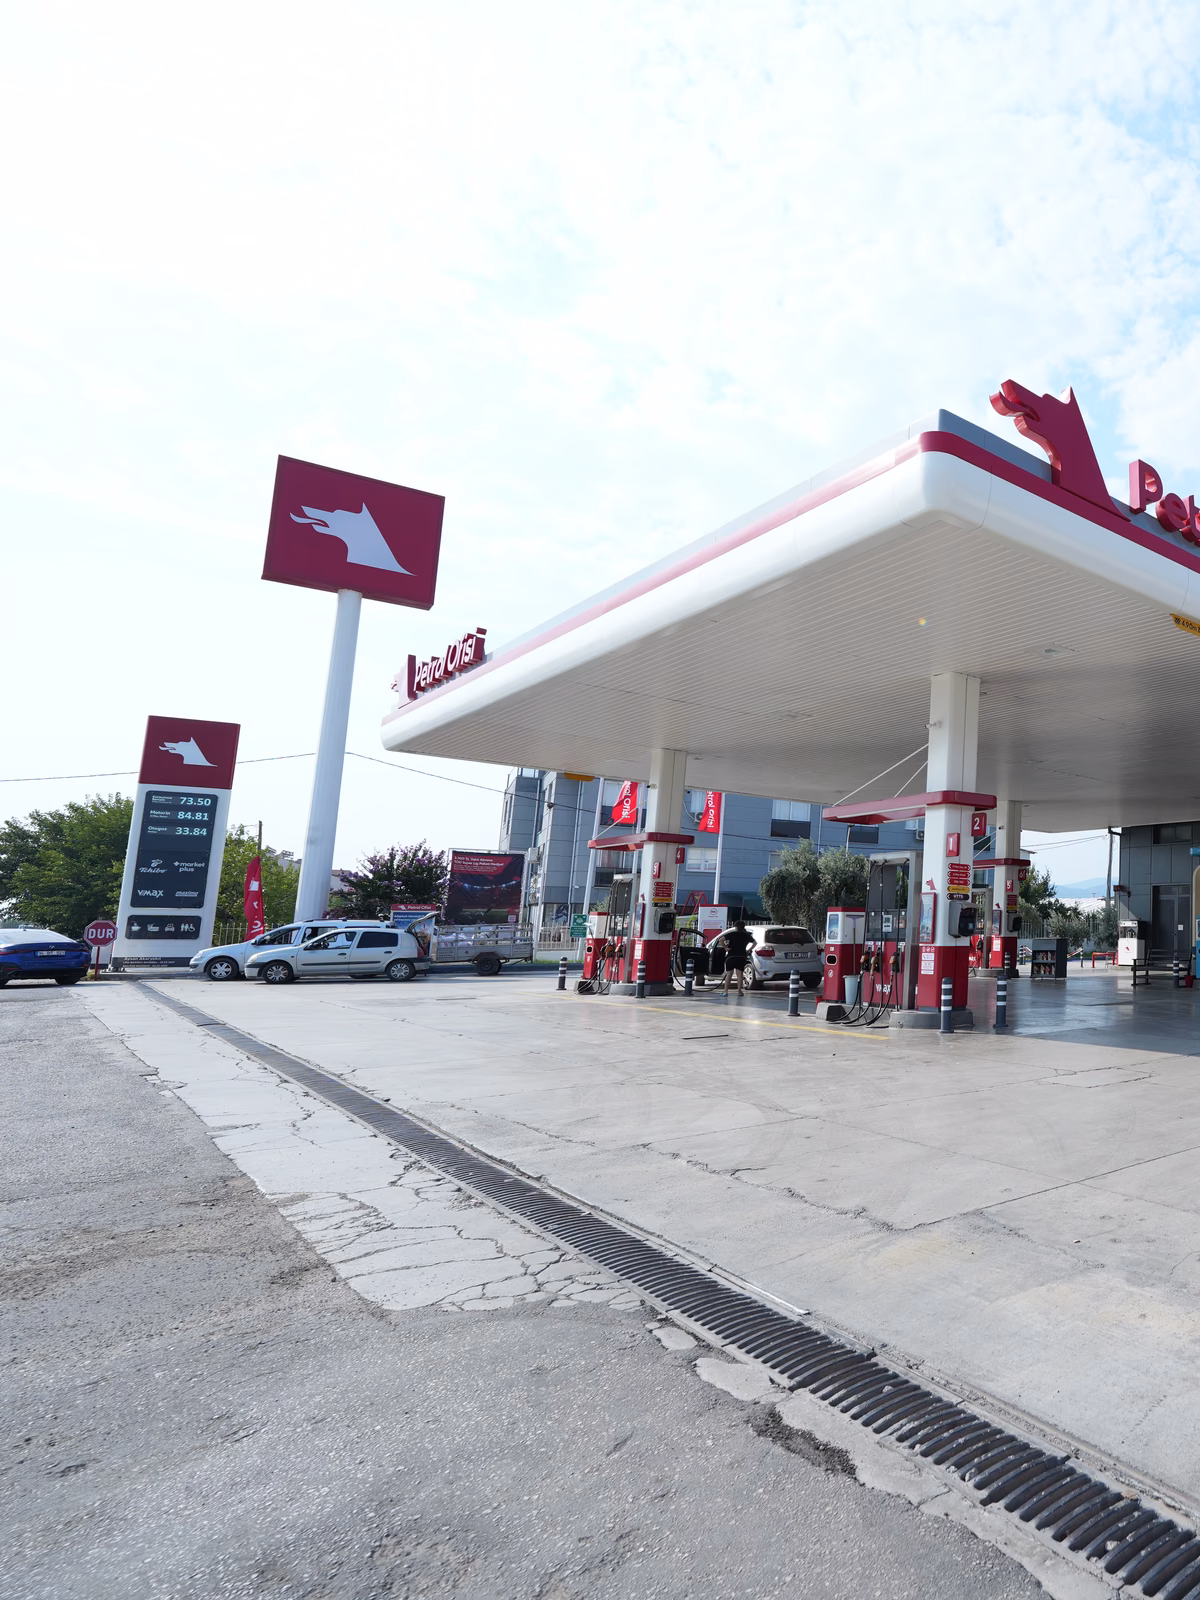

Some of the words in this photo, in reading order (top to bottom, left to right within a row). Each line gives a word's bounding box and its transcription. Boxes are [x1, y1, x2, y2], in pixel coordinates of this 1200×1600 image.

[180, 797, 211, 806] 73.50
[177, 811, 209, 821] 84.81
[973, 817, 980, 830] 2
[175, 826, 207, 836] 33.84
[88, 928, 114, 939] DUR
